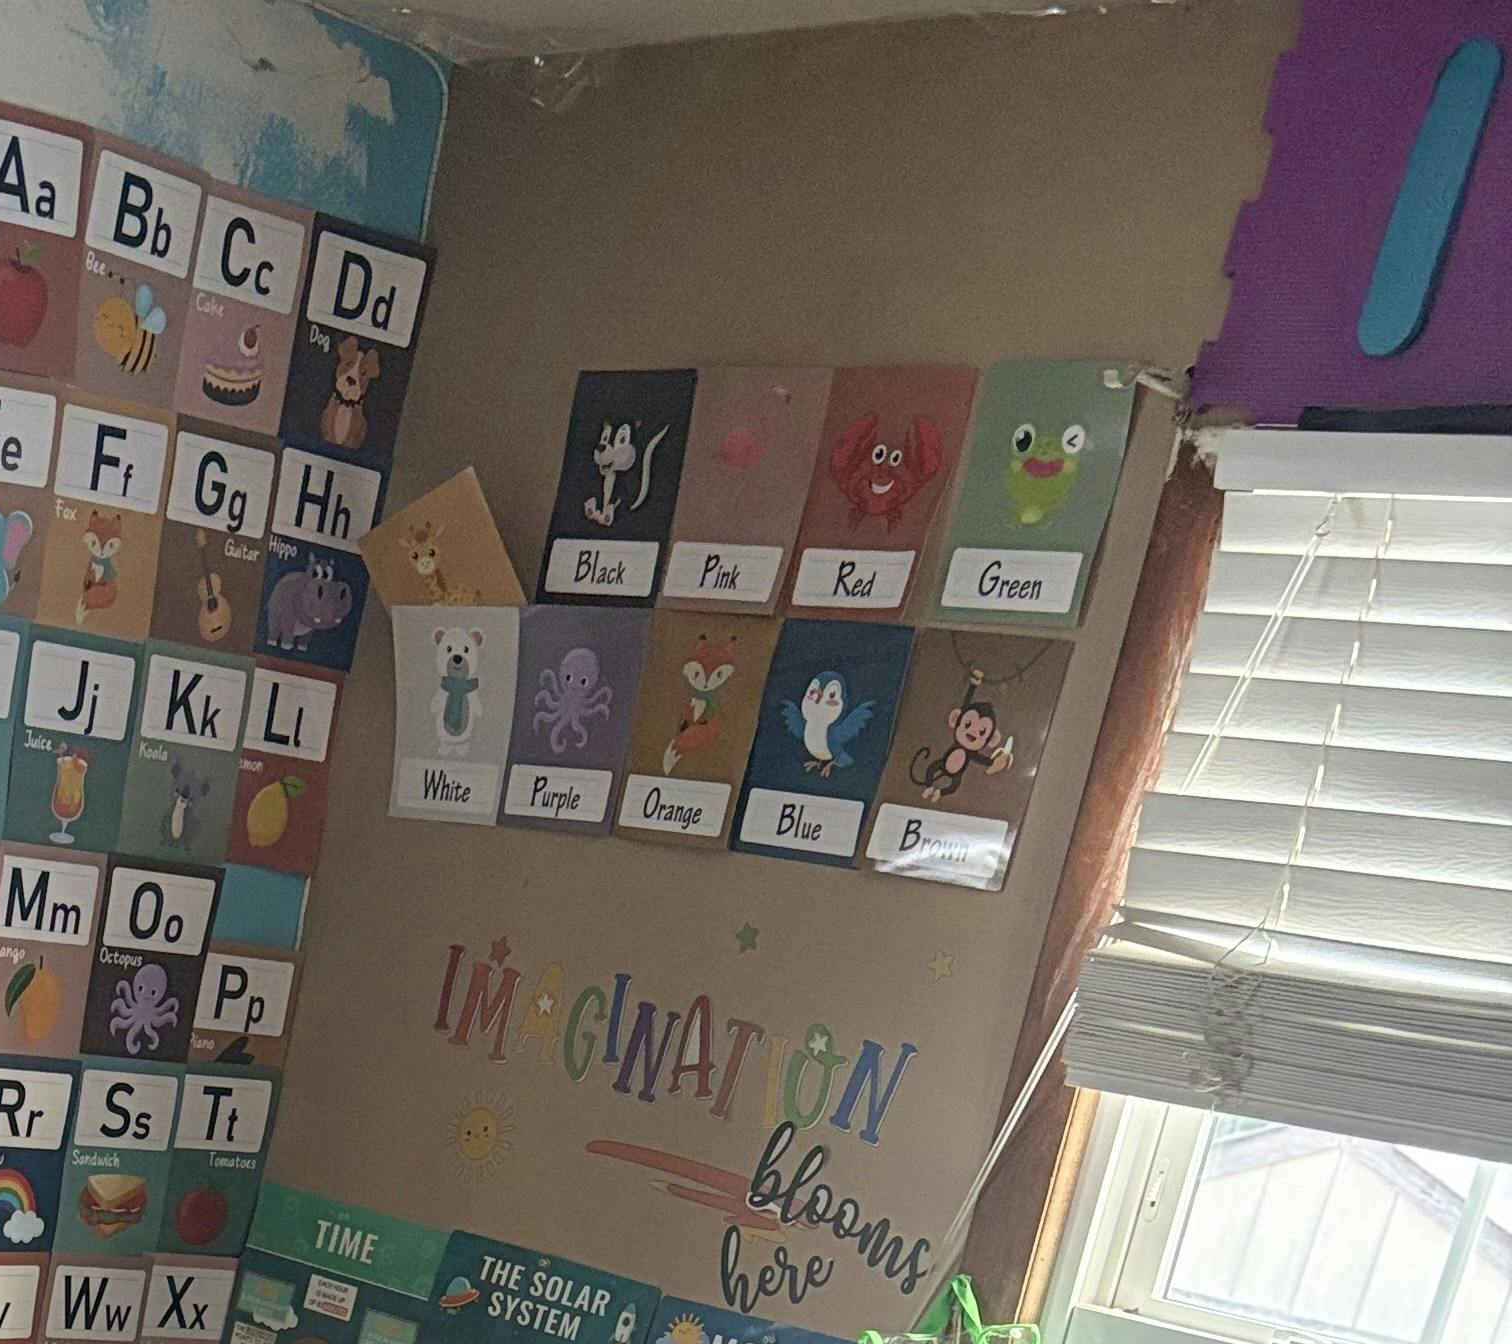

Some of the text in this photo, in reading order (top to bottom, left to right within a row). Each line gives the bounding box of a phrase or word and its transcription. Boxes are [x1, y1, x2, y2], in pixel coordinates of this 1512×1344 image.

[112, 172, 171, 258] Bb
[86, 251, 106, 275] Bee
[221, 218, 272, 297] Cc
[334, 251, 396, 330] Dd
[309, 325, 330, 352] Dog
[90, 424, 133, 497] Ff
[55, 498, 77, 519] Fox
[196, 451, 247, 533] Gg
[295, 464, 351, 539] Hh
[224, 538, 260, 562] Guitar
[270, 534, 297, 558] Hippo
[574, 554, 627, 588] Black
[699, 558, 742, 592] Pink
[833, 564, 875, 600] Red
[977, 562, 1042, 601] Green
[57, 660, 99, 736] Jj
[165, 669, 220, 739] Kk
[263, 682, 302, 748] Ll
[24, 730, 53, 751] Juice
[139, 740, 168, 763] Koala
[422, 770, 472, 805] White
[531, 776, 582, 816] Purple
[642, 786, 703, 828] Orange
[776, 803, 821, 843] Blue
[5, 868, 82, 936] Mm
[129, 881, 183, 944] Oo
[99, 946, 143, 968] Octopus
[213, 966, 264, 1033] Pp
[434, 943, 919, 1147] IMAGINATION
[99, 1082, 151, 1141] Ss
[202, 1086, 239, 1143] Tt
[72, 1148, 120, 1169] Sandwich
[208, 1151, 257, 1171] Tomatoes
[747, 1121, 931, 1296] blooms
[315, 1219, 379, 1266] TIME
[480, 1255, 612, 1317] THE SOLAR
[721, 1225, 833, 1314] here
[64, 1274, 132, 1331] Ww
[157, 1275, 208, 1331] Xx
[488, 1292, 582, 1342] SYSTEM
